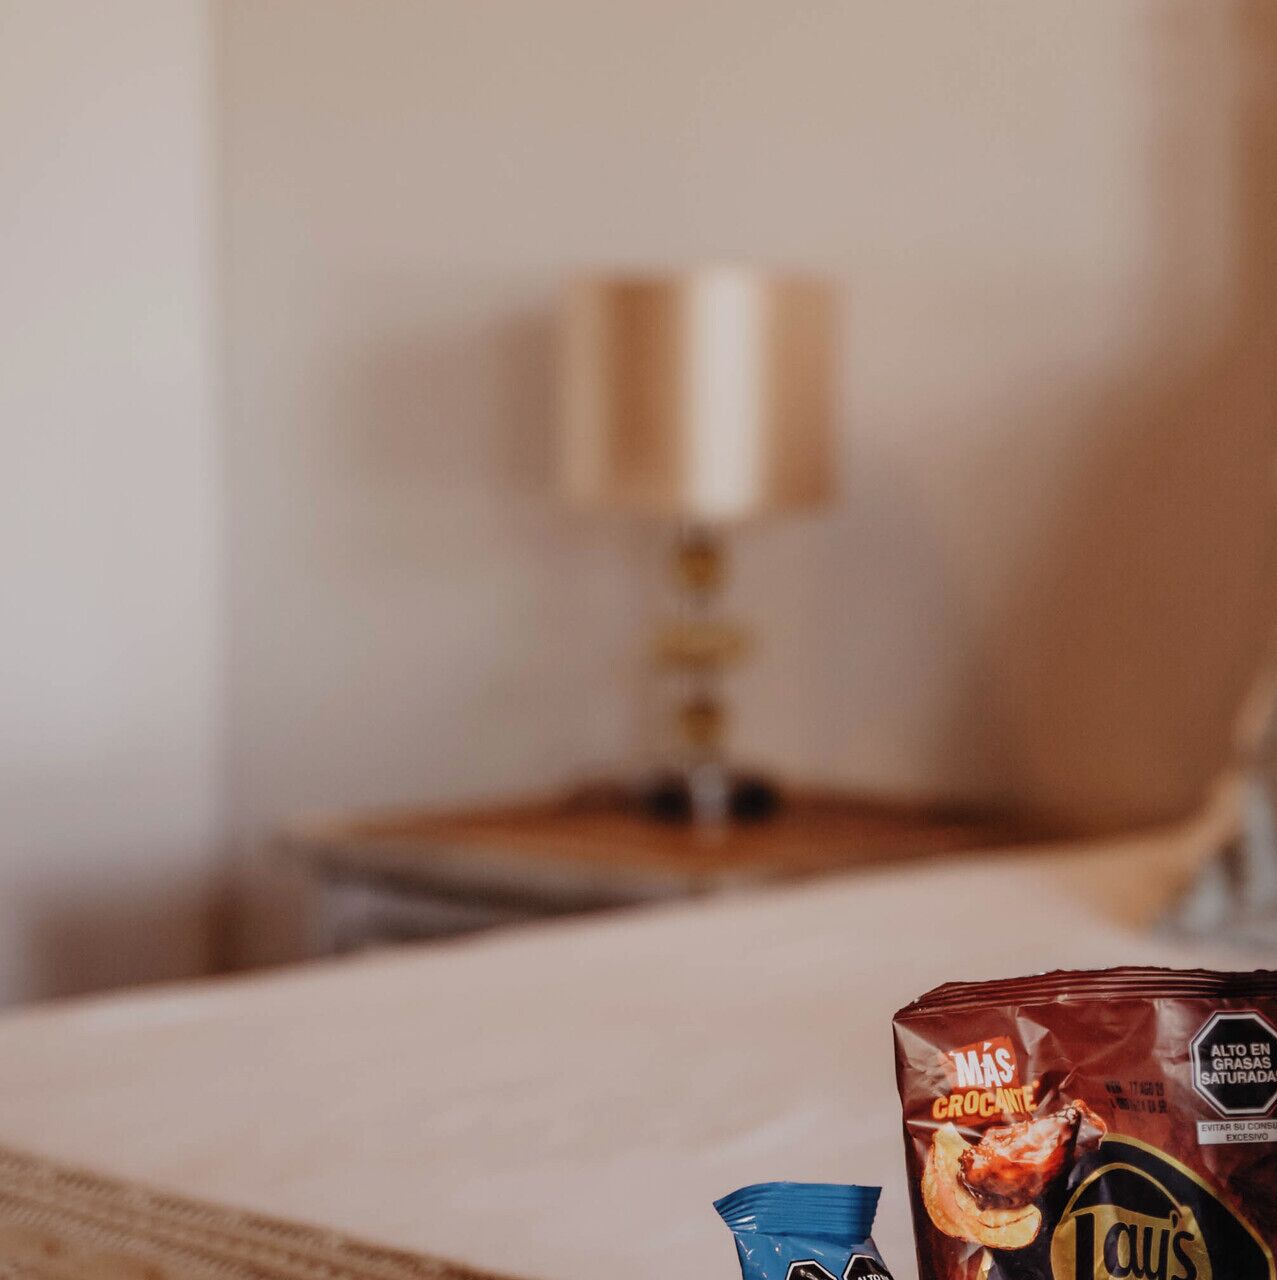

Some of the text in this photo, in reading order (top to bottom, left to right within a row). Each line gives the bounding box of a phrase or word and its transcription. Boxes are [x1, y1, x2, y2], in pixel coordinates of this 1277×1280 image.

[1211, 1043, 1271, 1057] ALTO EN
[949, 1042, 1015, 1088] MÁS
[1212, 1057, 1272, 1071] GRASAS
[932, 1084, 1038, 1119] CROCANTE
[1201, 1123, 1232, 1132] EVITAR
[1234, 1122, 1246, 1130] SU
[1226, 1132, 1269, 1142] EXCESIVO
